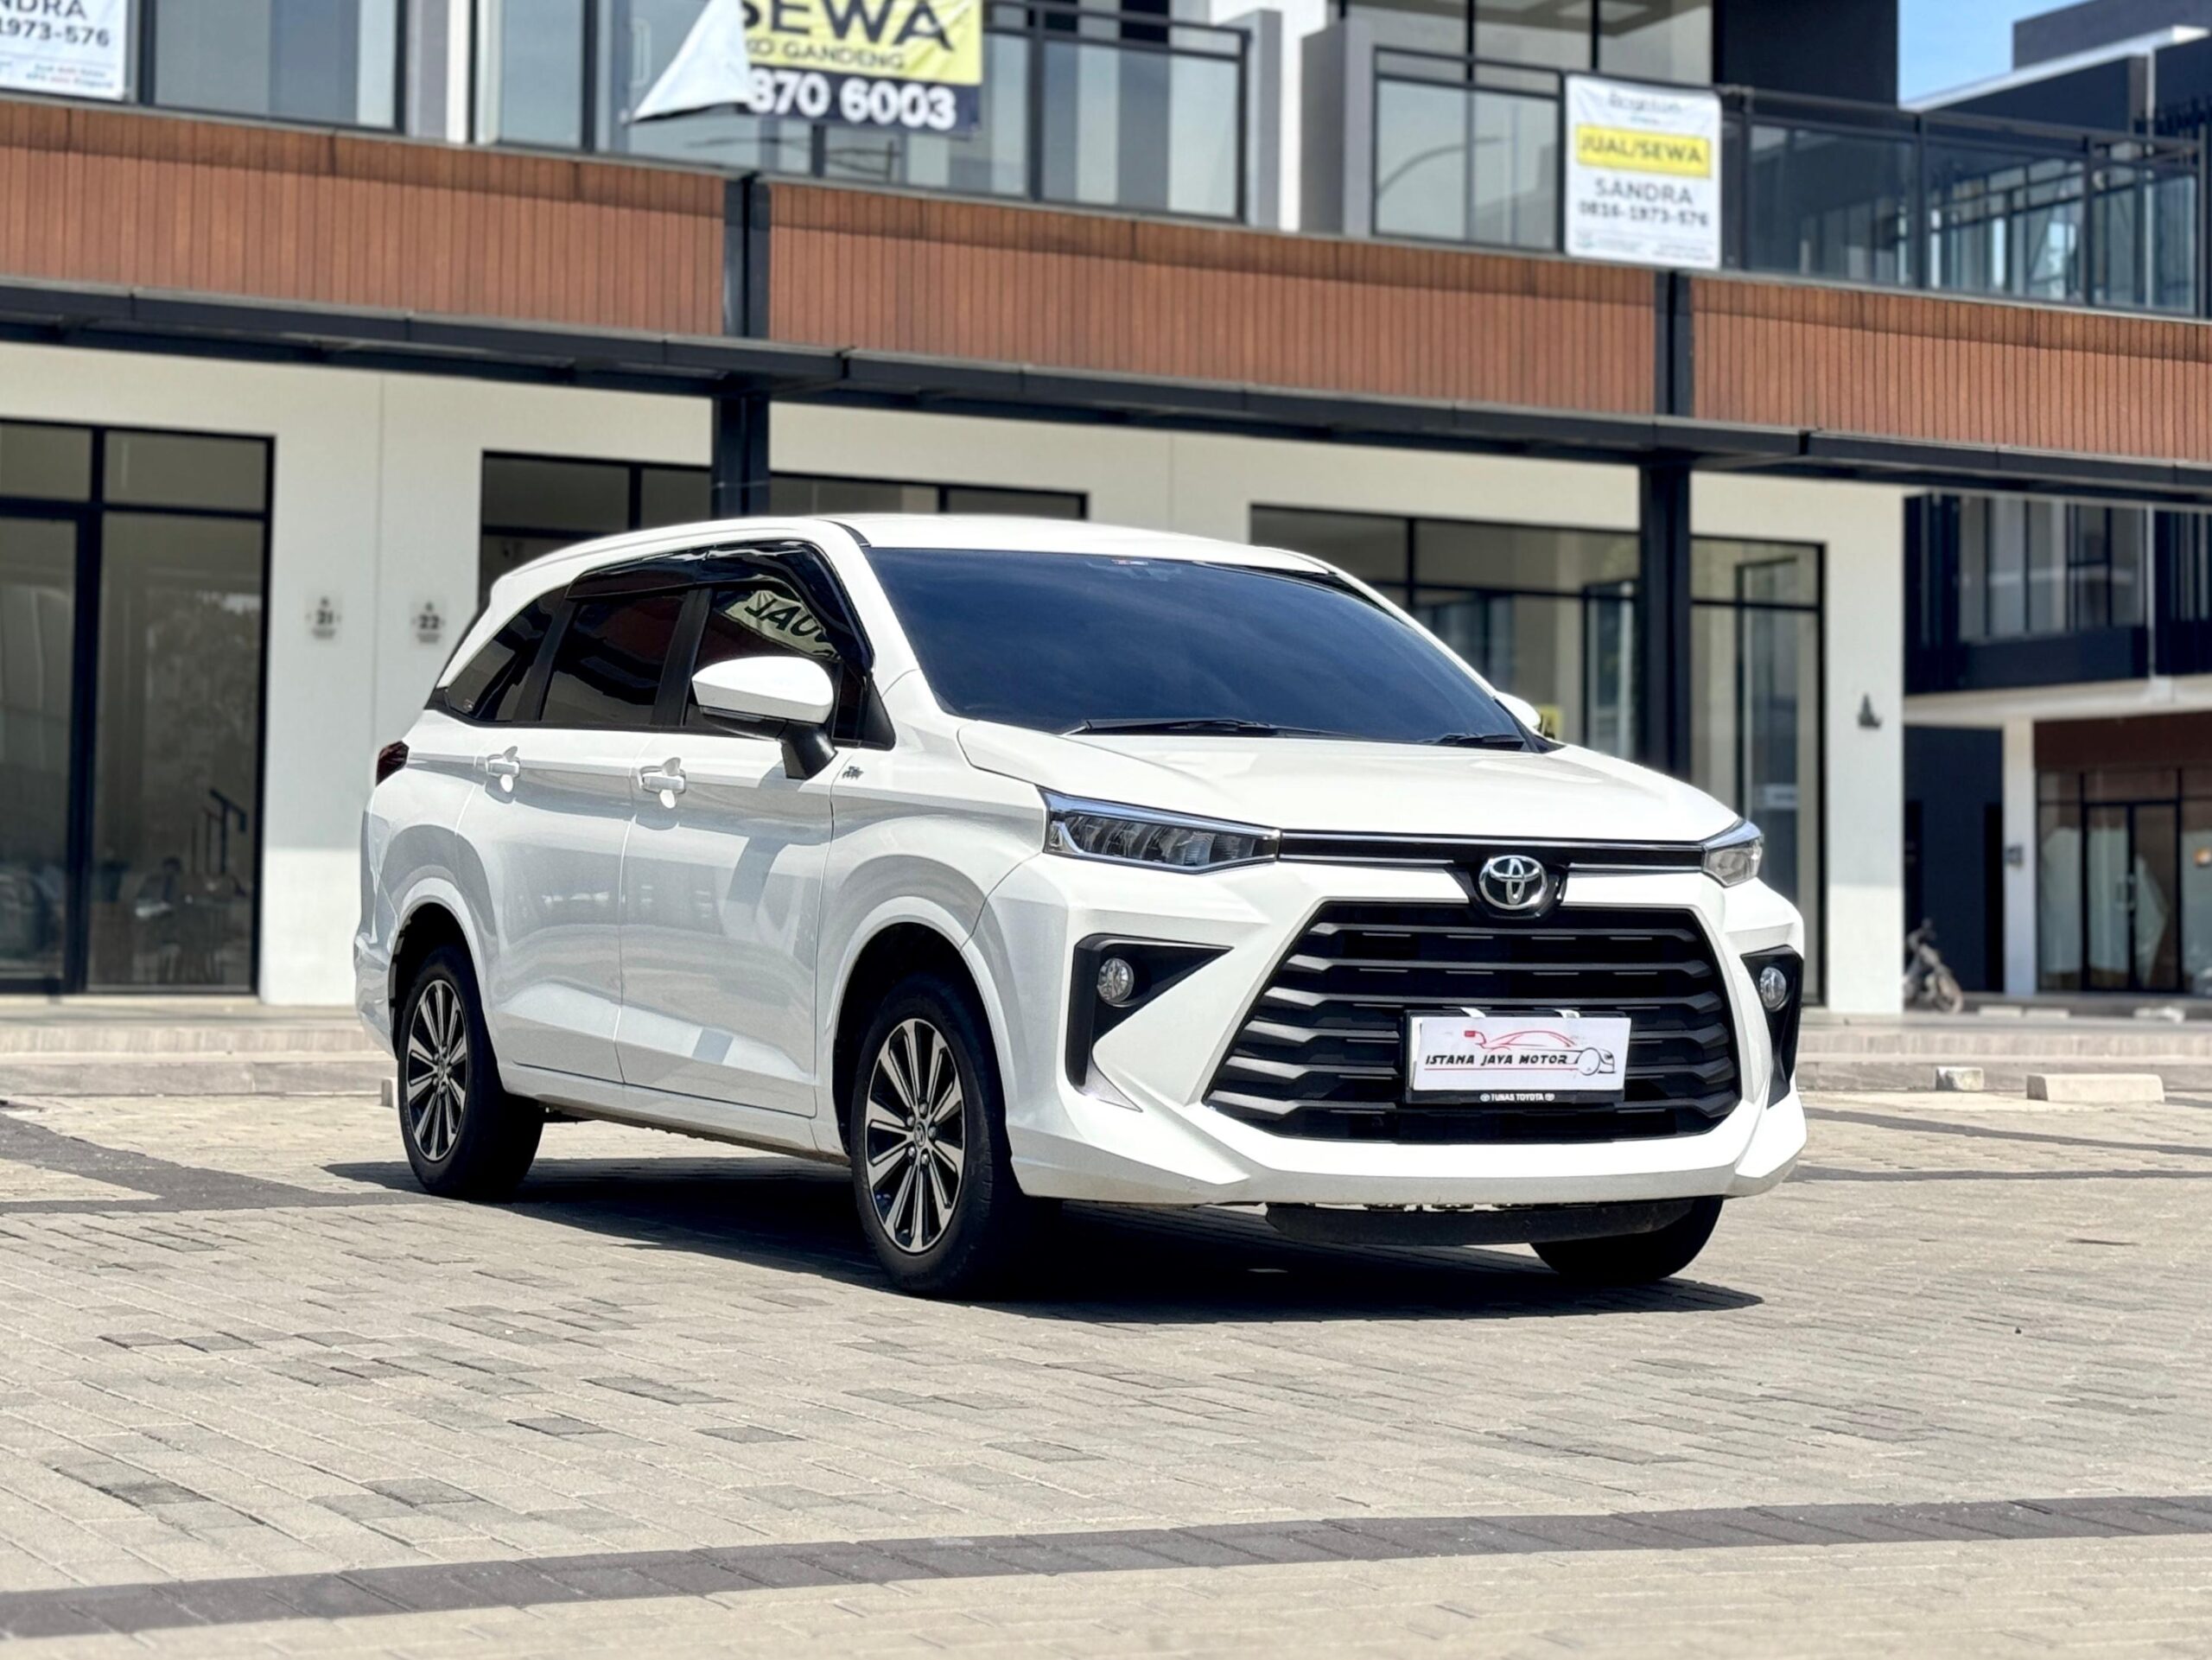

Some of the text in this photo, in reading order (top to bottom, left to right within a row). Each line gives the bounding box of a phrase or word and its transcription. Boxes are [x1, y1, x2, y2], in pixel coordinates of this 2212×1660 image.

[0, 0, 87, 20] DRA
[783, 40, 906, 69] GANDENG
[840, 78, 956, 130] 6003
[1581, 136, 1703, 163] JUAL/SEWA
[1595, 178, 1694, 205] SANDRA
[1426, 1054, 1567, 1065] ISTANA JAYA MOTOR
[1491, 1093, 1544, 1102] TUNAS TOYOTA
